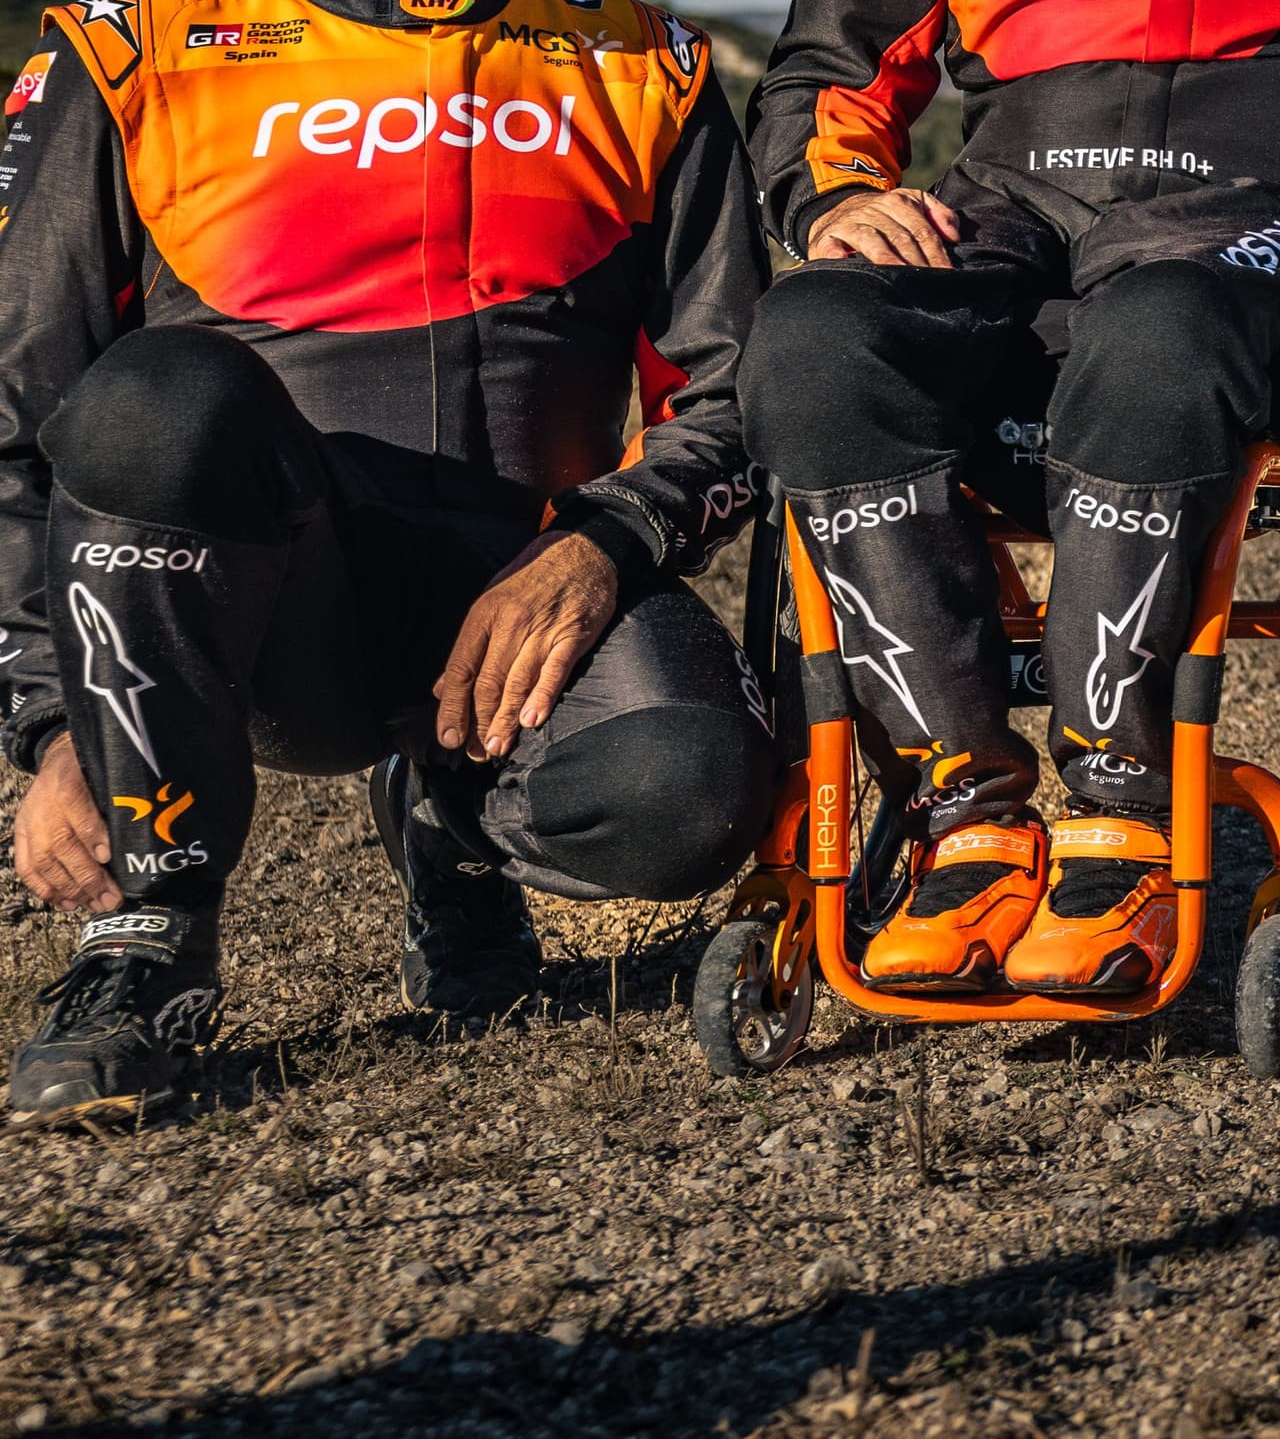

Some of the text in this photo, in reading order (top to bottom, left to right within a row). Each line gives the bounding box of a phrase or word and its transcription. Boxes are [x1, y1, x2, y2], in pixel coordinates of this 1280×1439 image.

[246, 26, 305, 37] GAZOO
[247, 18, 311, 30] TOYOTA
[187, 32, 241, 48] GR
[245, 35, 303, 45] Racing
[499, 21, 580, 55] MGS
[223, 49, 278, 62] Spain
[12, 71, 47, 96] eps
[252, 92, 576, 169] repsol
[1064, 488, 1183, 539] repsol
[70, 542, 208, 573] repsol
[1088, 770, 1126, 785] Seguros
[930, 805, 958, 819] eguros
[125, 841, 209, 874] MGS
